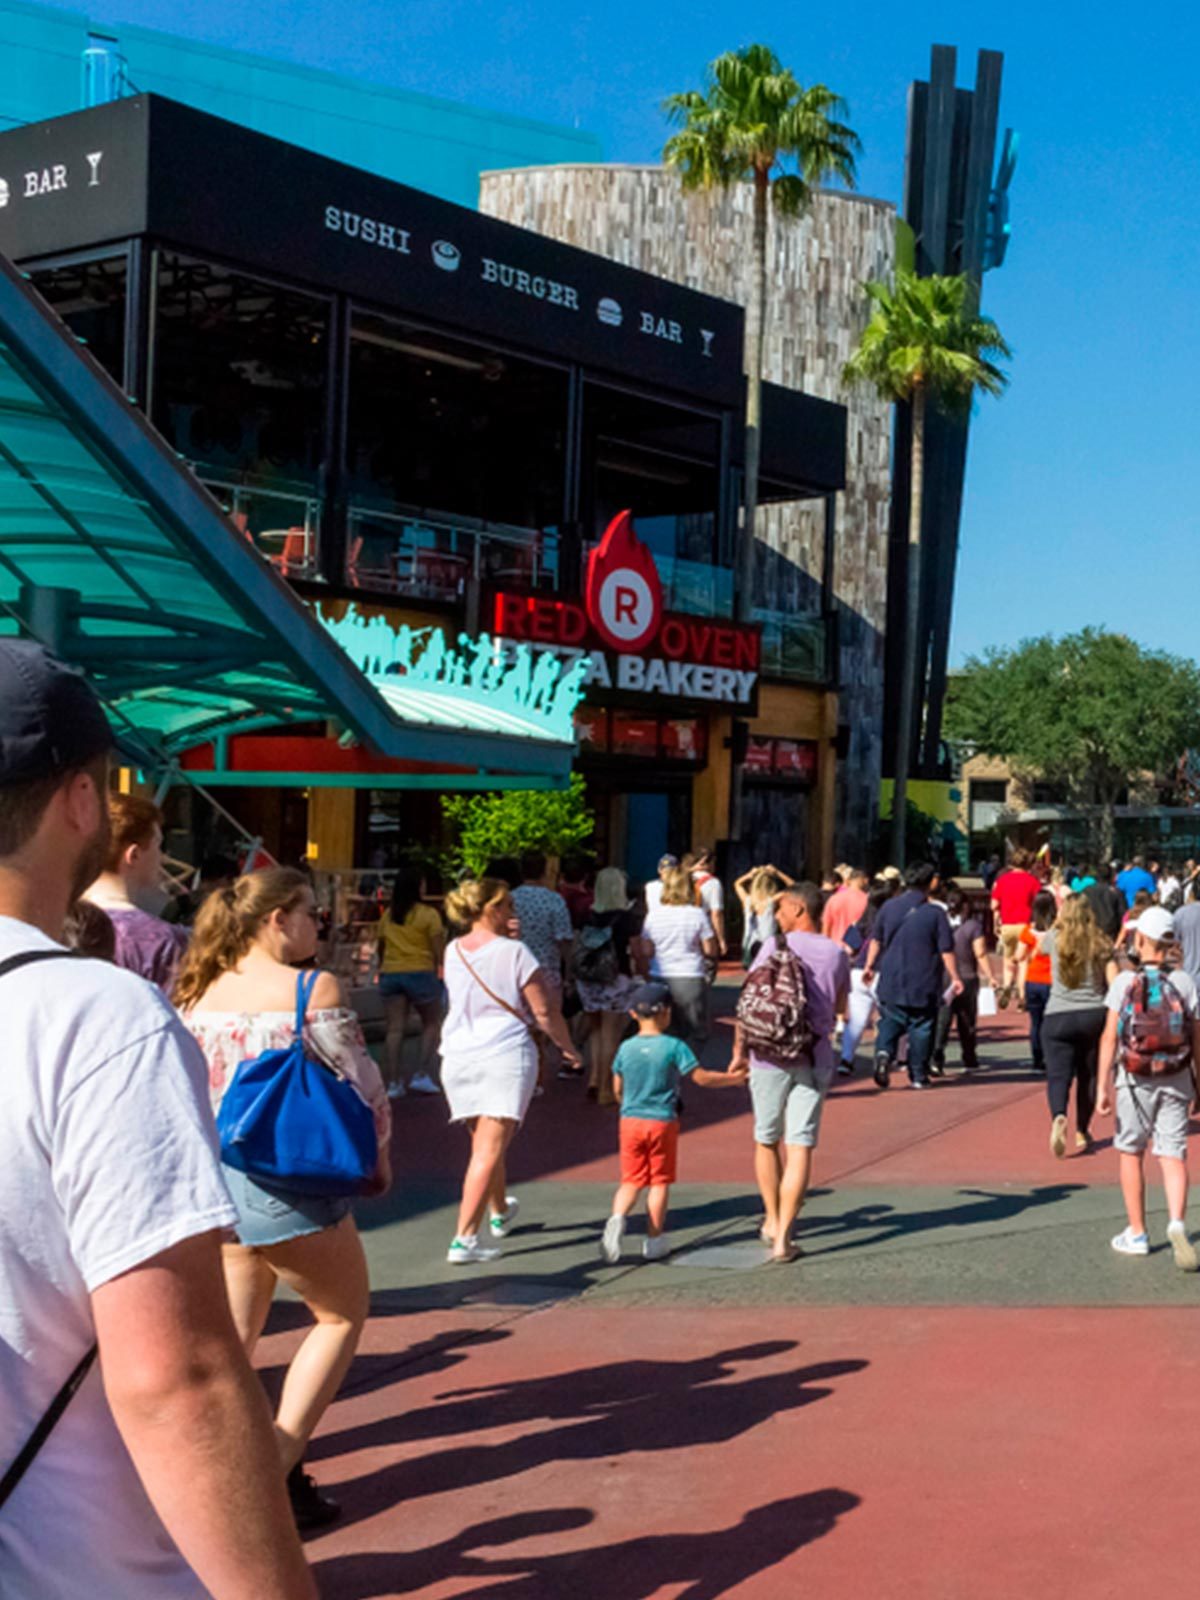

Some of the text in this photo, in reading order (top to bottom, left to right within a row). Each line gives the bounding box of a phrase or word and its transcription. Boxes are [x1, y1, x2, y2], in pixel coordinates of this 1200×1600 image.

[23, 164, 68, 197] BAR
[325, 206, 684, 344] SUSHI BURGER BAR
[495, 592, 758, 669] RED OVEN
[615, 586, 638, 625] R
[493, 637, 758, 703] PZA BAKERY
